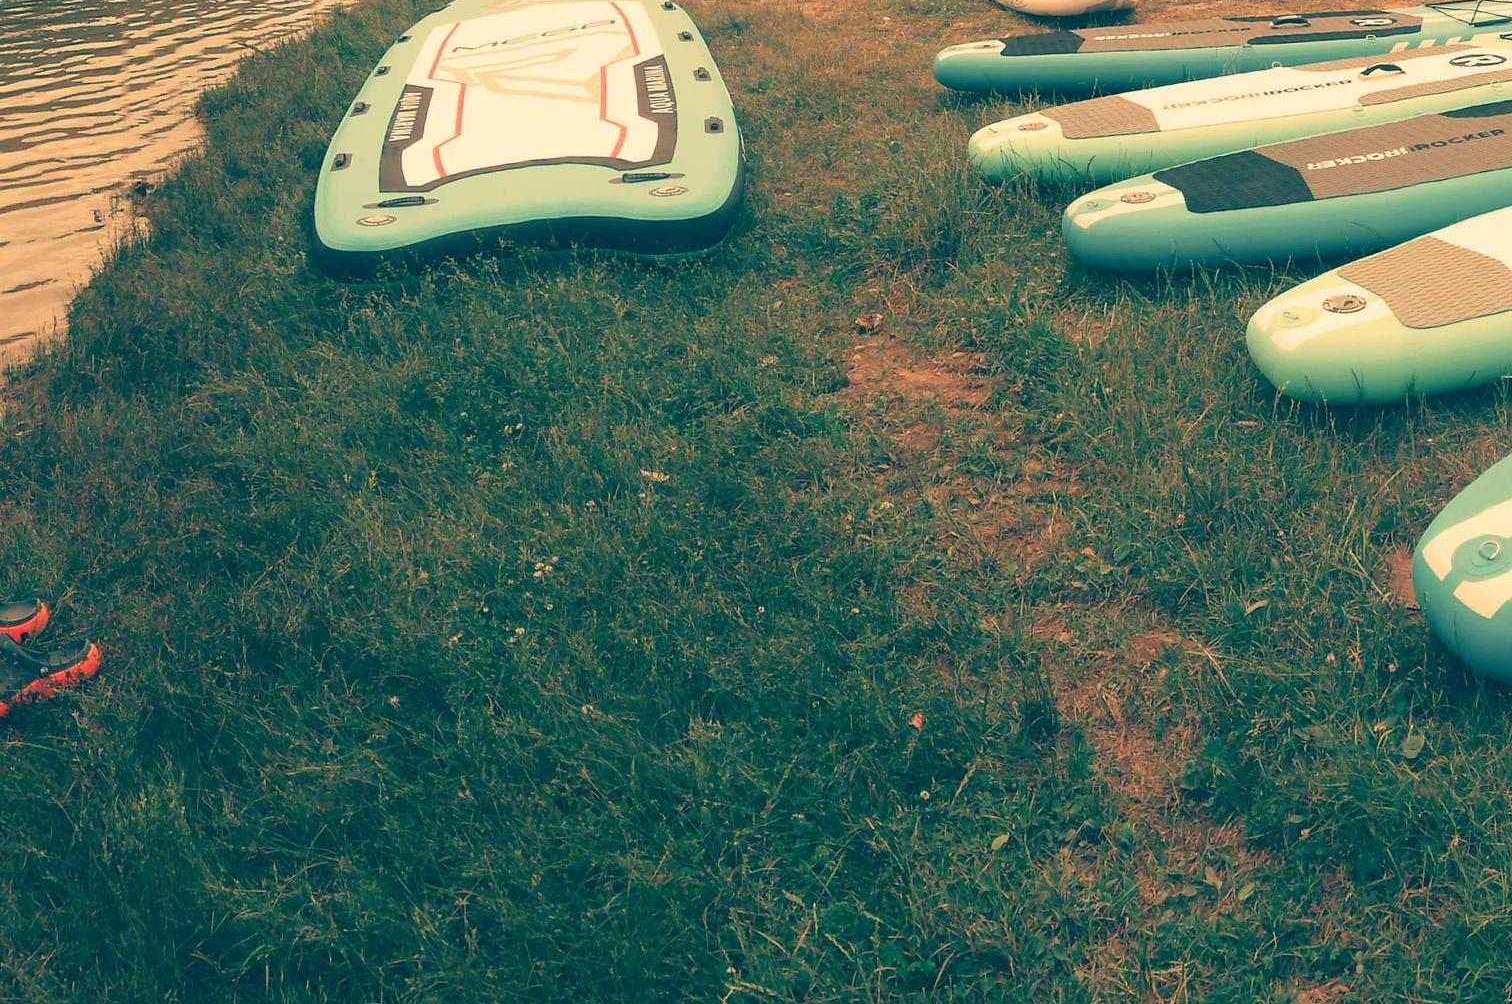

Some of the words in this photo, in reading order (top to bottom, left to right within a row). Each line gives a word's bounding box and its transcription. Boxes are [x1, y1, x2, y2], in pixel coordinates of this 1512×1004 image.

[643, 65, 668, 92] MARINA
[398, 92, 423, 111] AQUA
[647, 91, 676, 114] AQUA
[388, 110, 418, 142] MARINA
[1409, 128, 1506, 153] iROCKER
[1306, 146, 1410, 171] iROCKER
